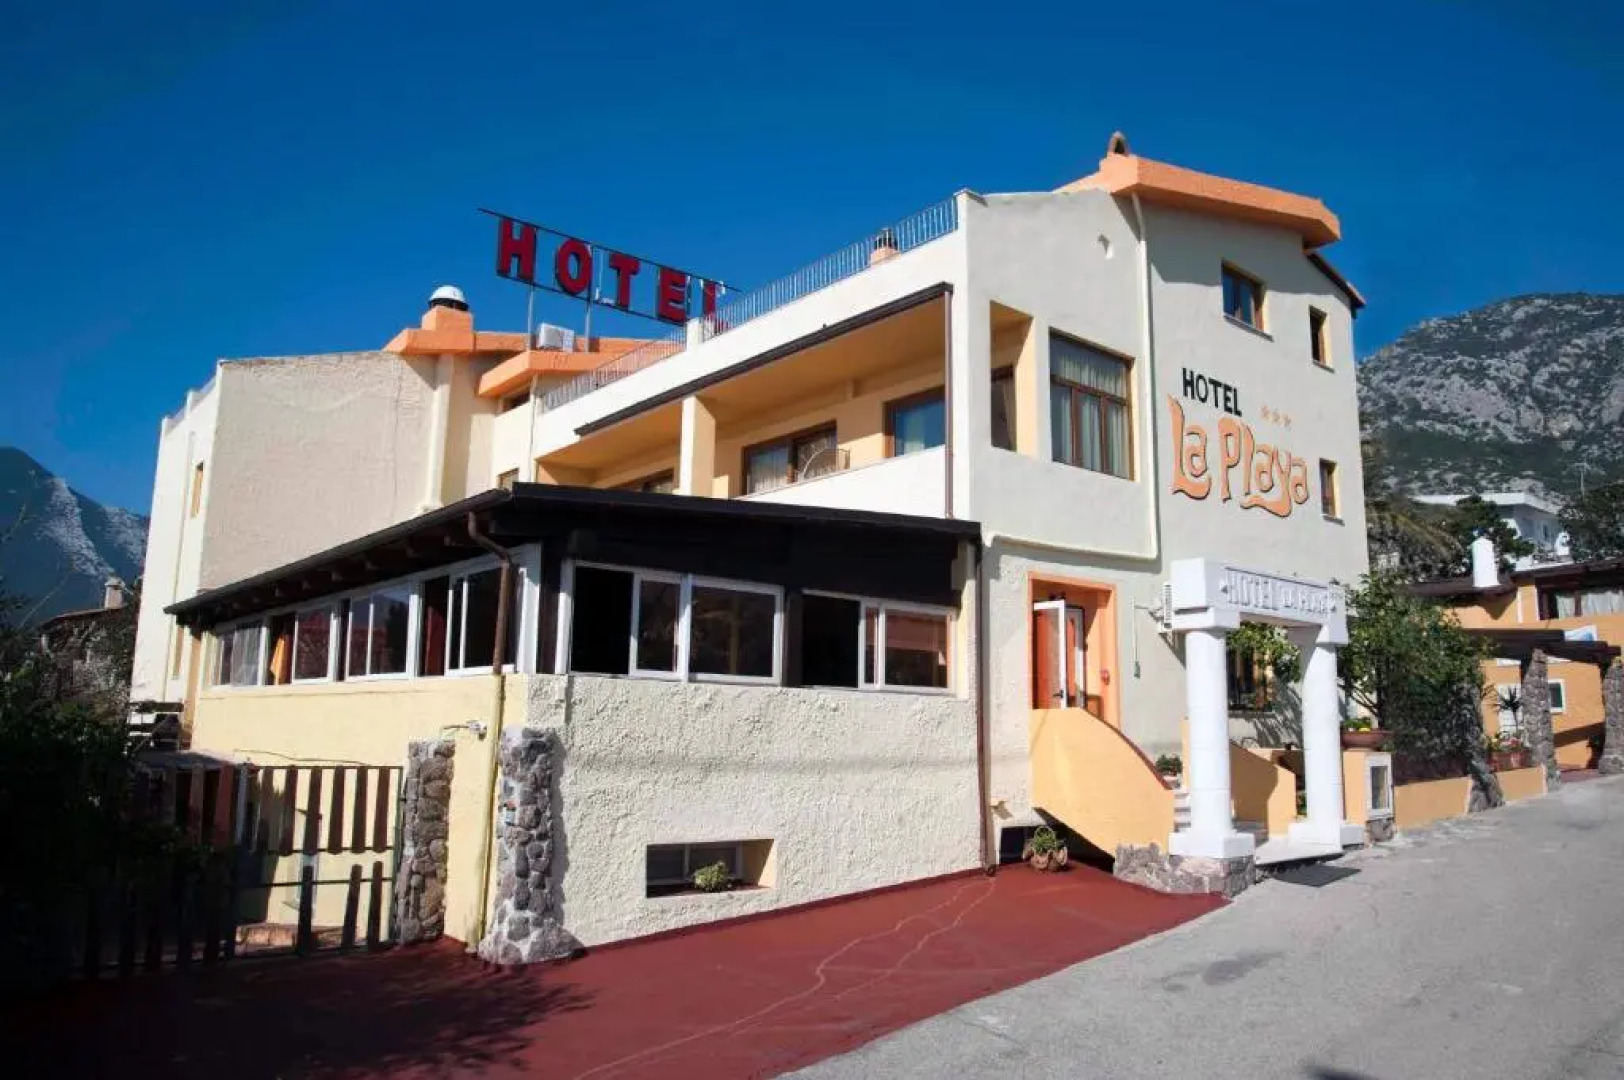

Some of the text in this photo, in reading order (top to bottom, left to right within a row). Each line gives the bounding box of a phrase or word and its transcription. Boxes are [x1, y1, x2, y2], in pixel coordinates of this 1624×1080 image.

[1182, 367, 1242, 417] HOTEL
[1167, 394, 1309, 518] La Playa
